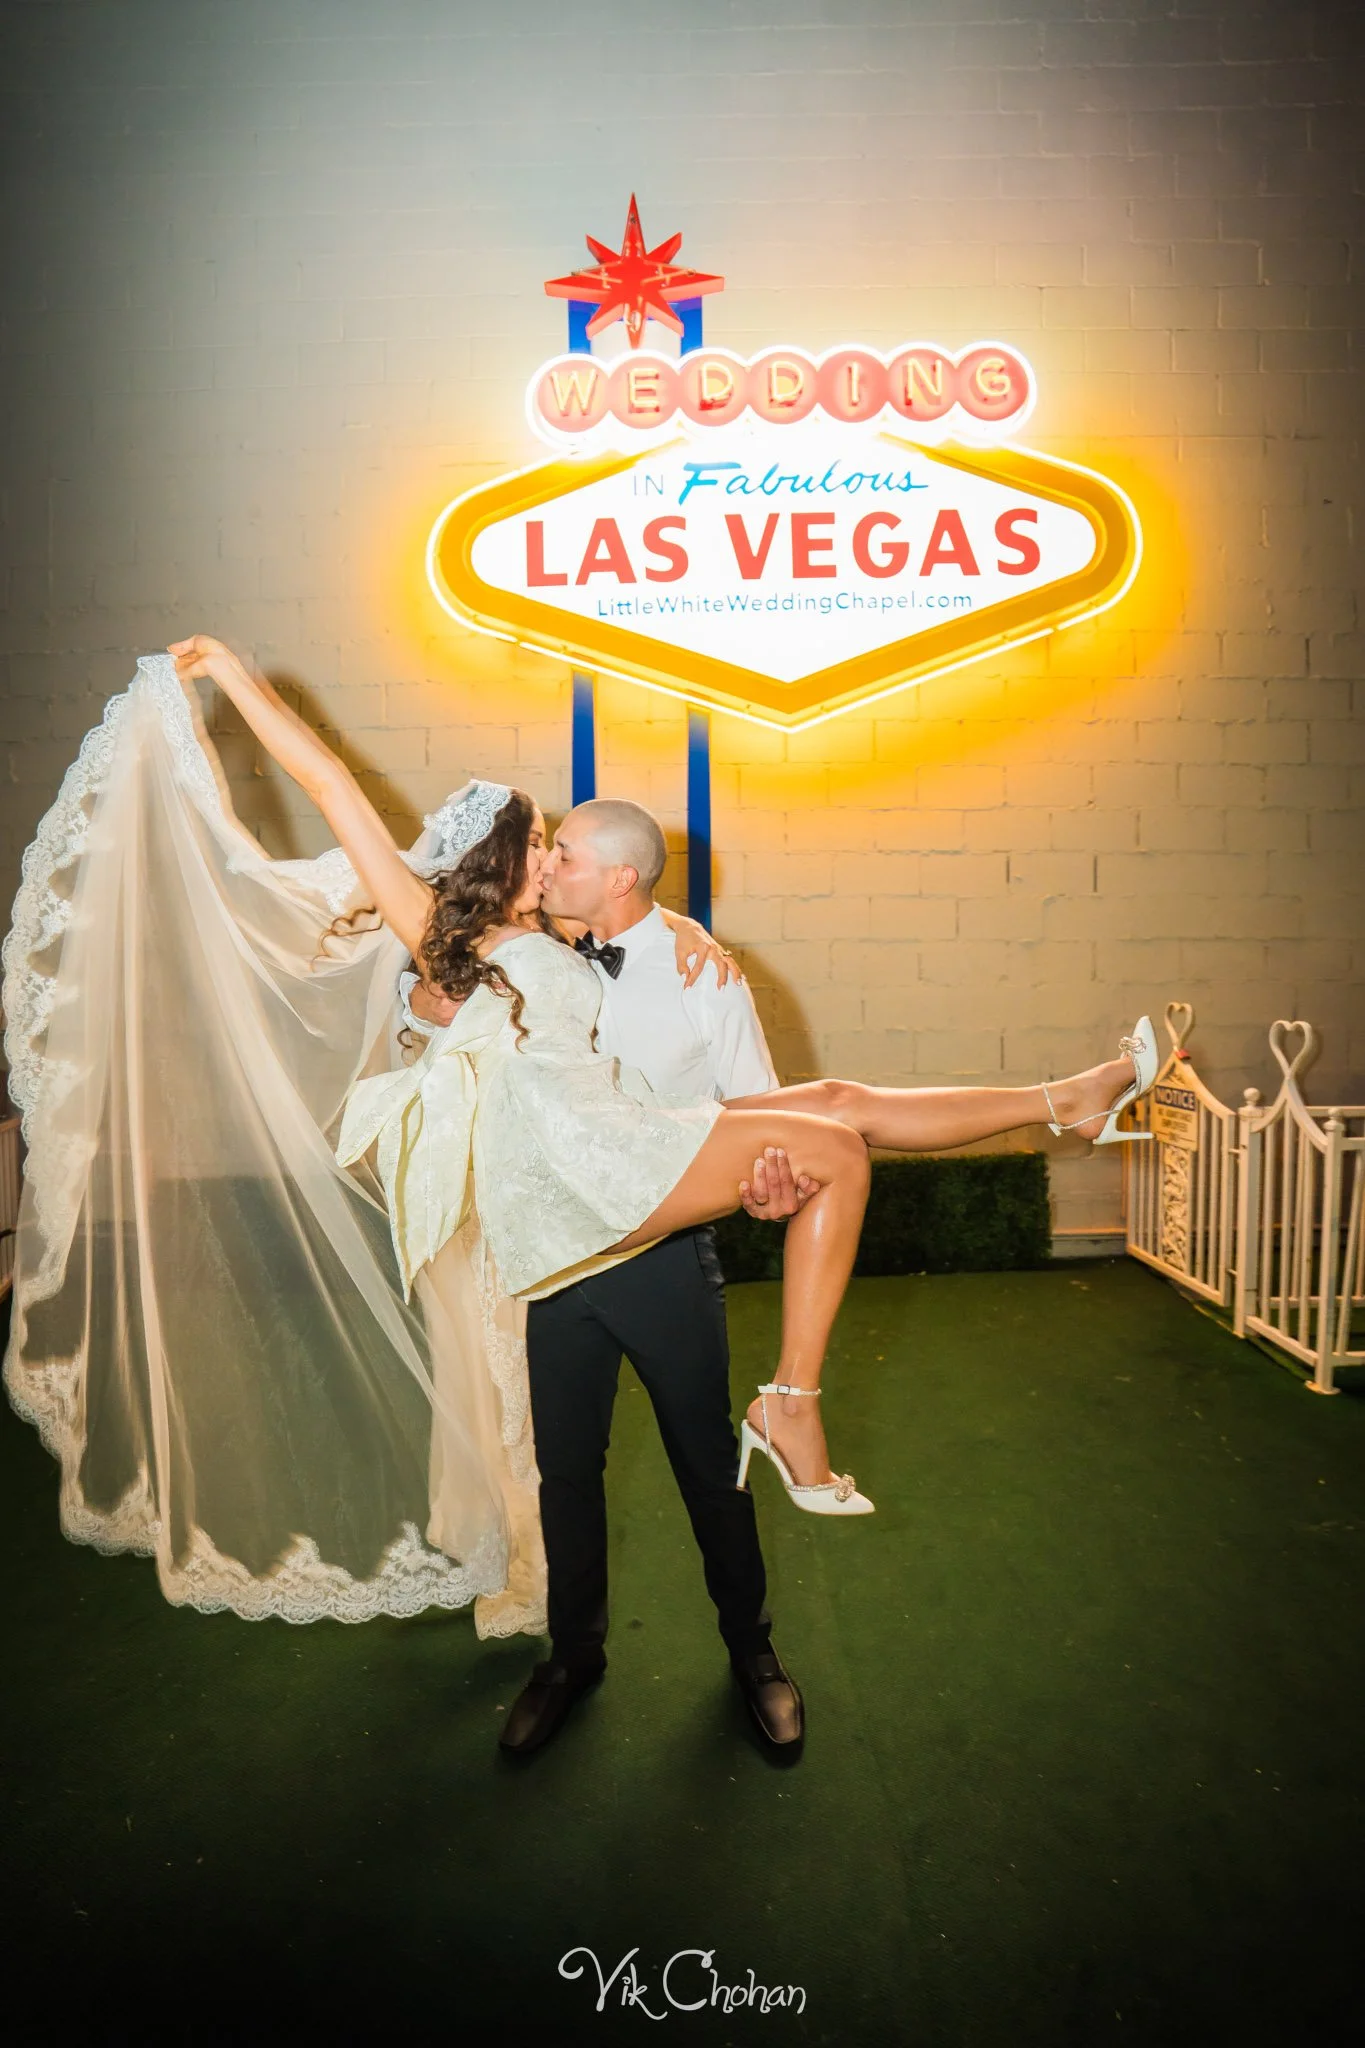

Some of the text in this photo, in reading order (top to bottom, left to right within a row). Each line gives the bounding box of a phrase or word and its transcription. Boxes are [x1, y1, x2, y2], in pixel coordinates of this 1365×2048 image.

[549, 356, 1012, 417] WEDDING
[633, 460, 930, 506] IN Fabulous
[525, 509, 1041, 587] LAS VEGAS
[597, 590, 973, 618] LittleWhiteWeddingChapel.com
[1156, 1087, 1196, 1110] NOTICE
